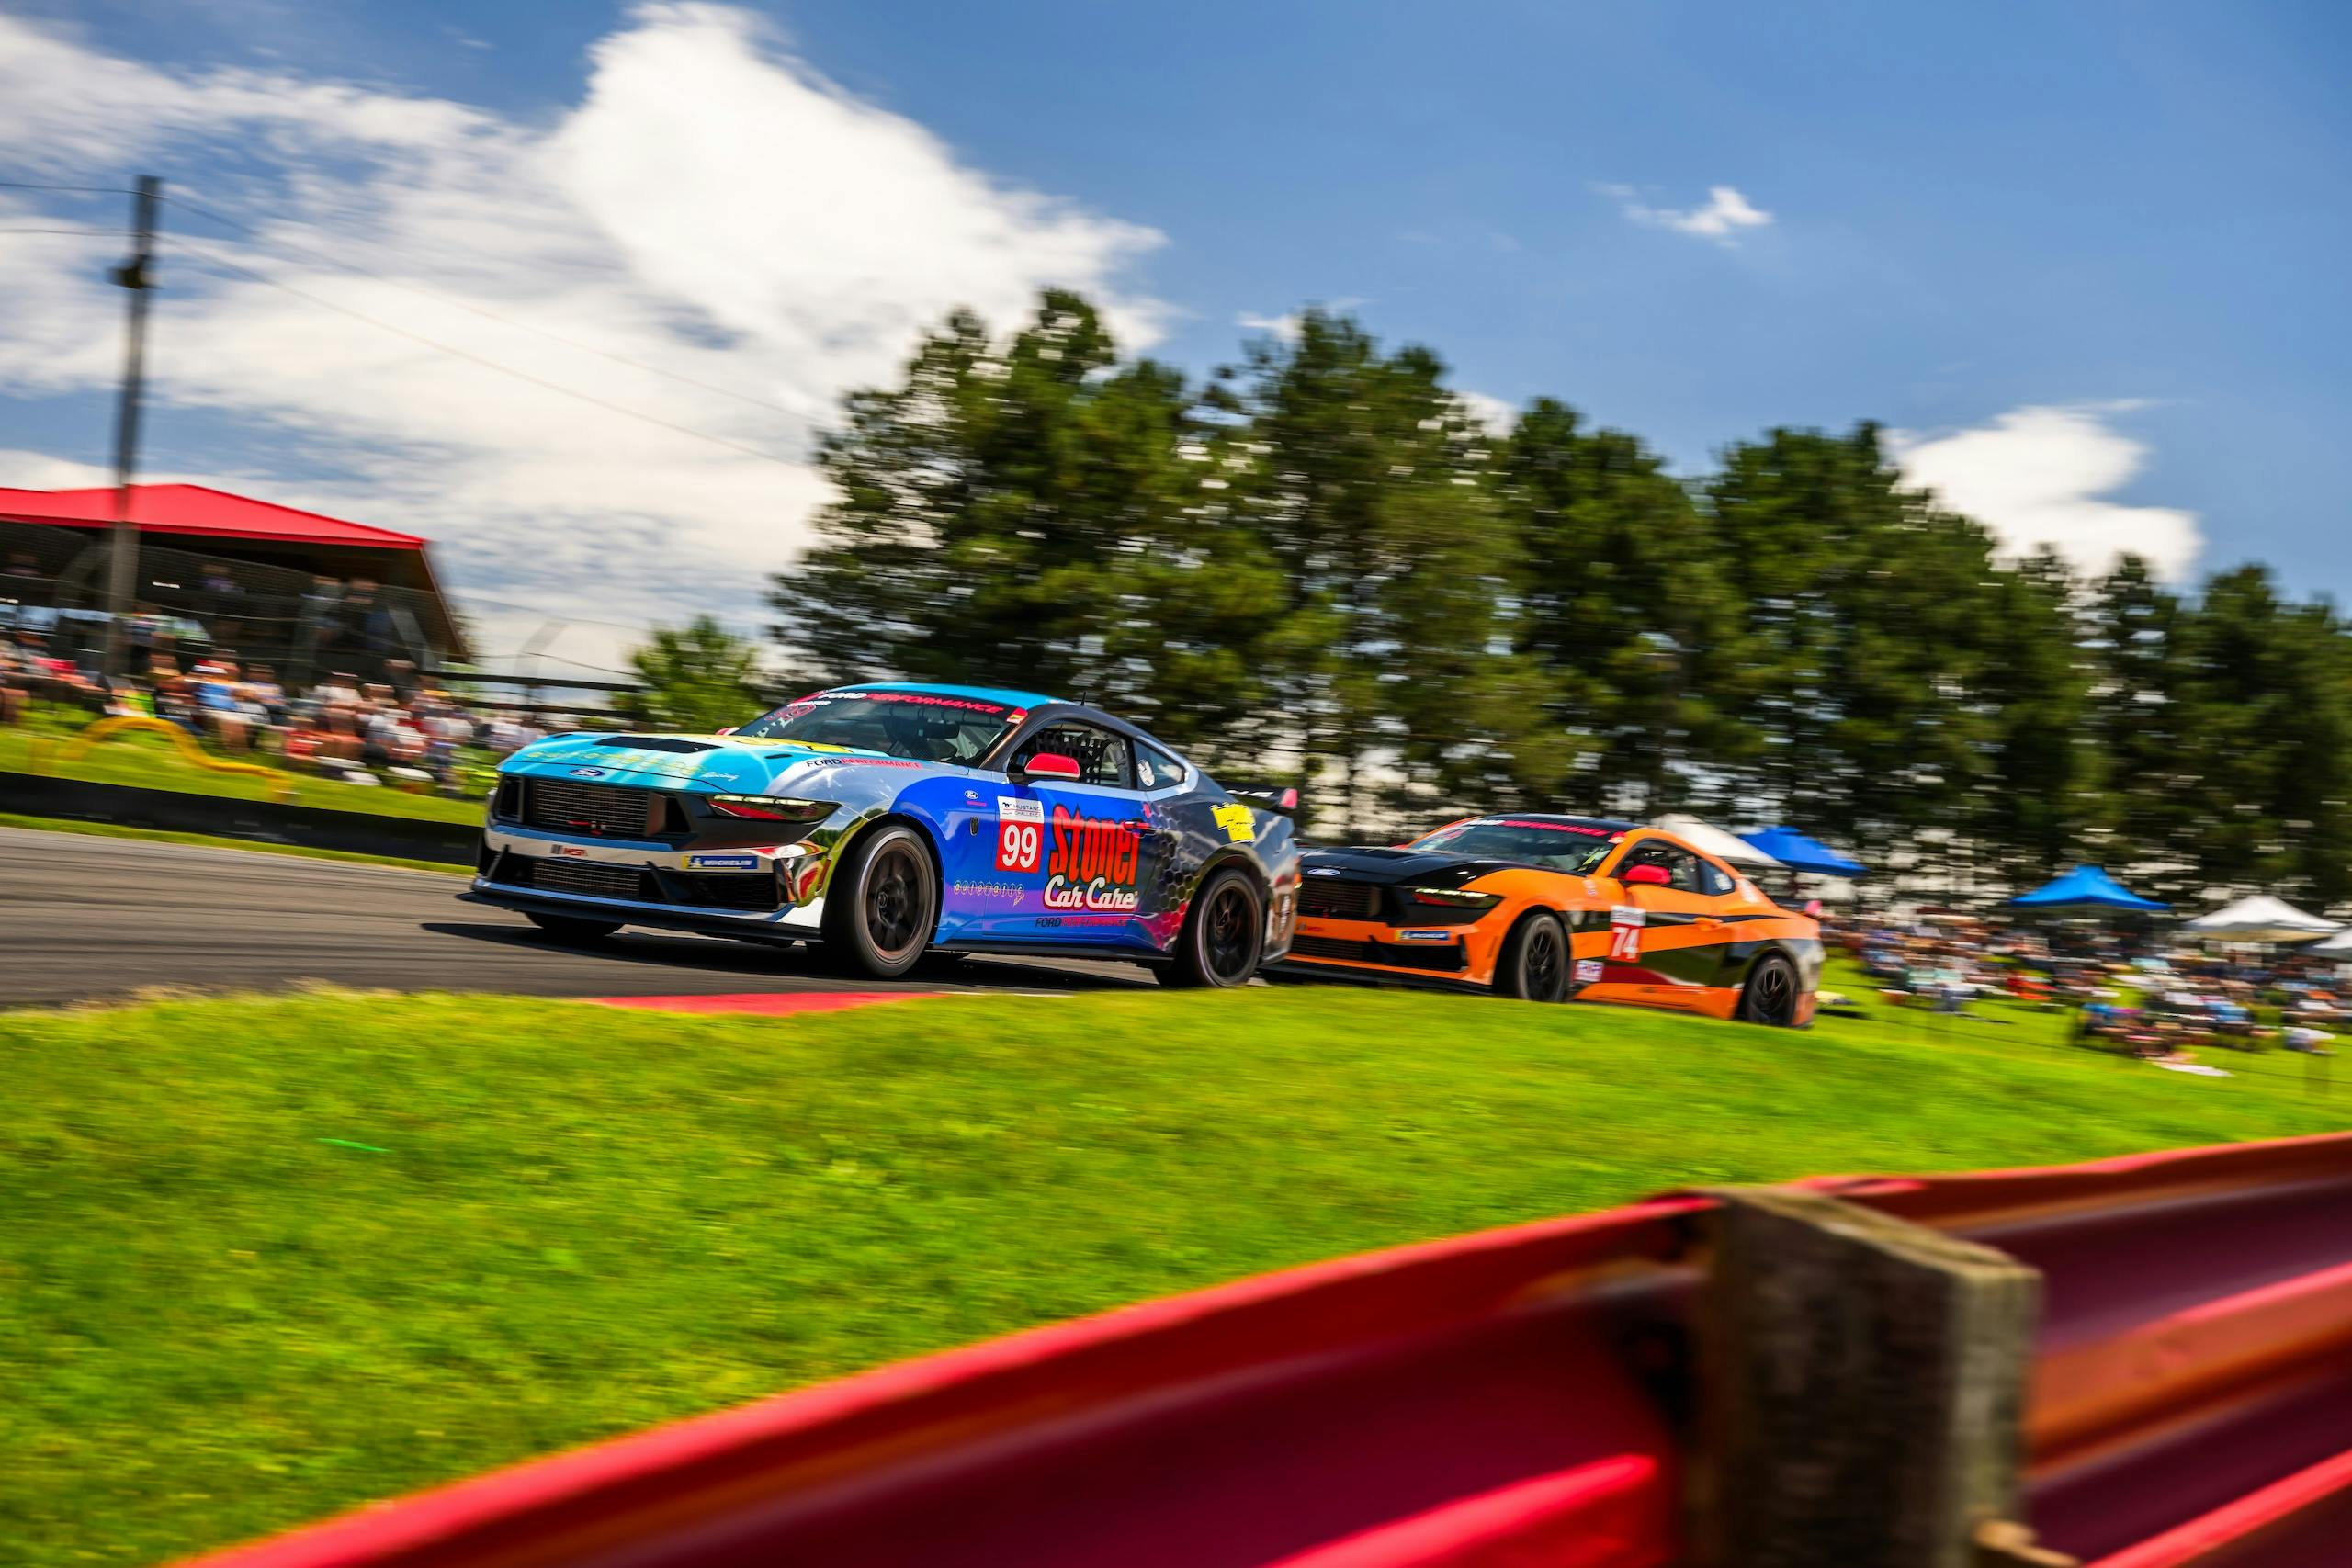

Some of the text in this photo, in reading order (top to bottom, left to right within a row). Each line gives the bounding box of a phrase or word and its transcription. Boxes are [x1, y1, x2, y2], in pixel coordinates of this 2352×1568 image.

[1002, 824, 1038, 868] 99
[1050, 805, 1138, 885] Stoner
[1044, 874, 1083, 908] Car
[1086, 876, 1137, 909] Care
[1611, 926, 1640, 959] 74
